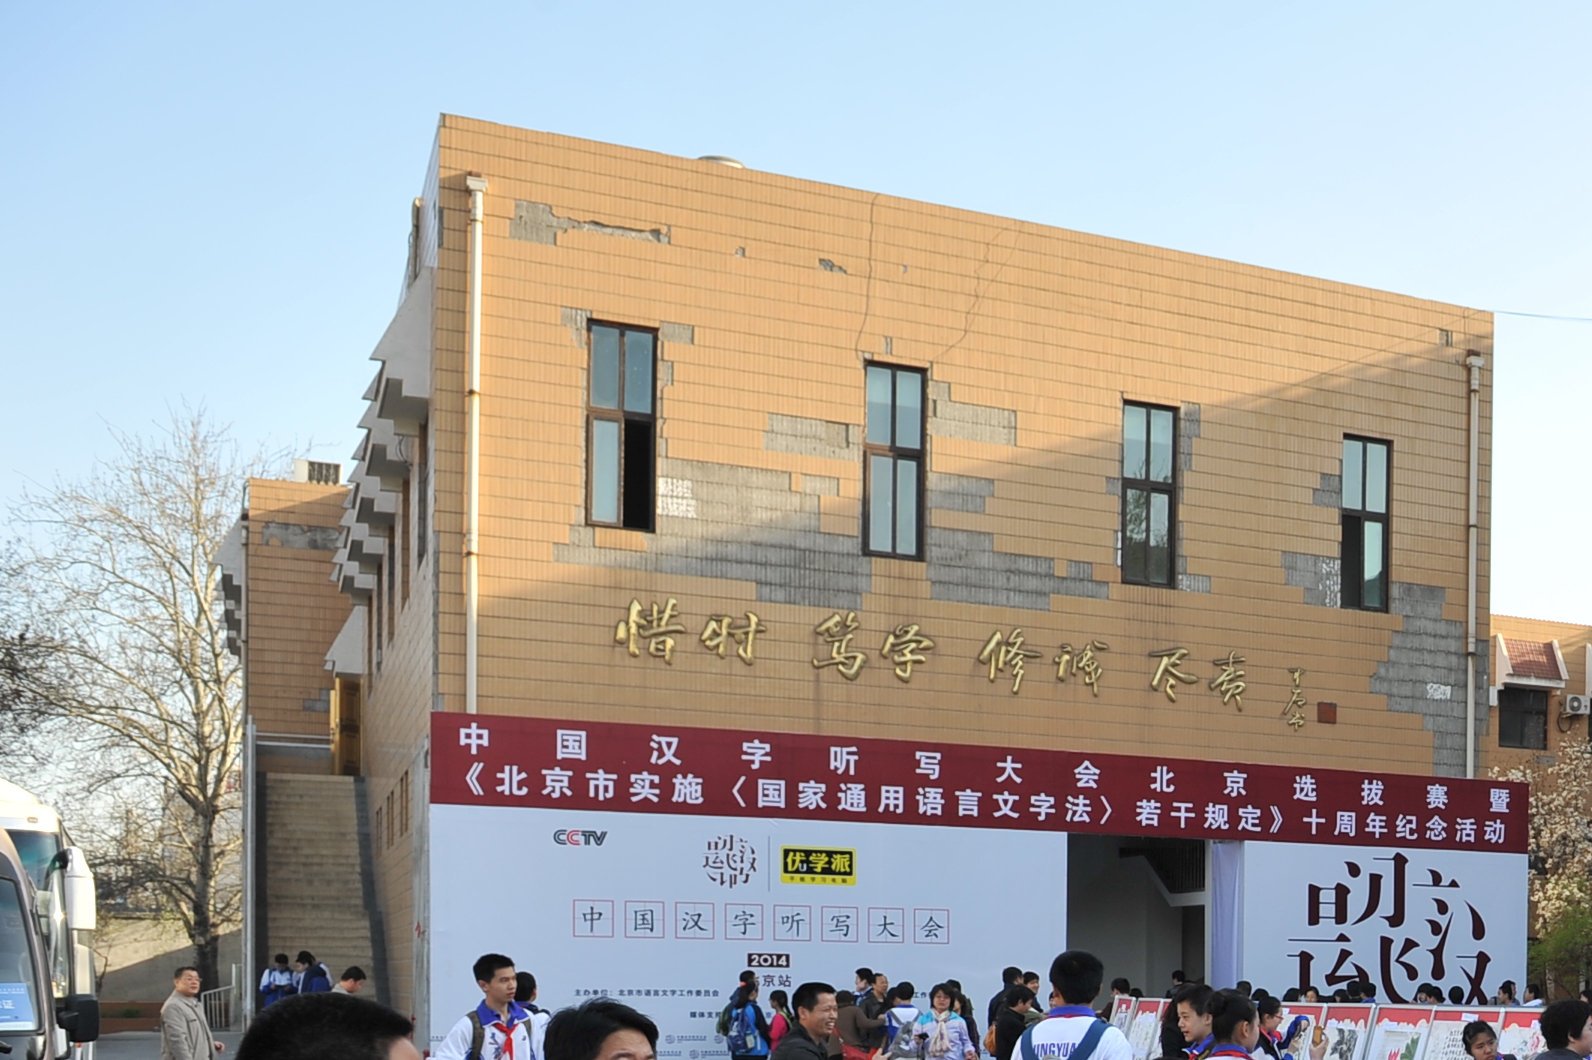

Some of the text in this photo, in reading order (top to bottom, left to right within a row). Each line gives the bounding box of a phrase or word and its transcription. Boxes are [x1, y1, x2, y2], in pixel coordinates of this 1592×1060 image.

[553, 829, 608, 846] CCTV
[581, 906, 945, 939] 中国汉字听写大会
[750, 954, 788, 967] 2014
[754, 974, 792, 988] 京站
